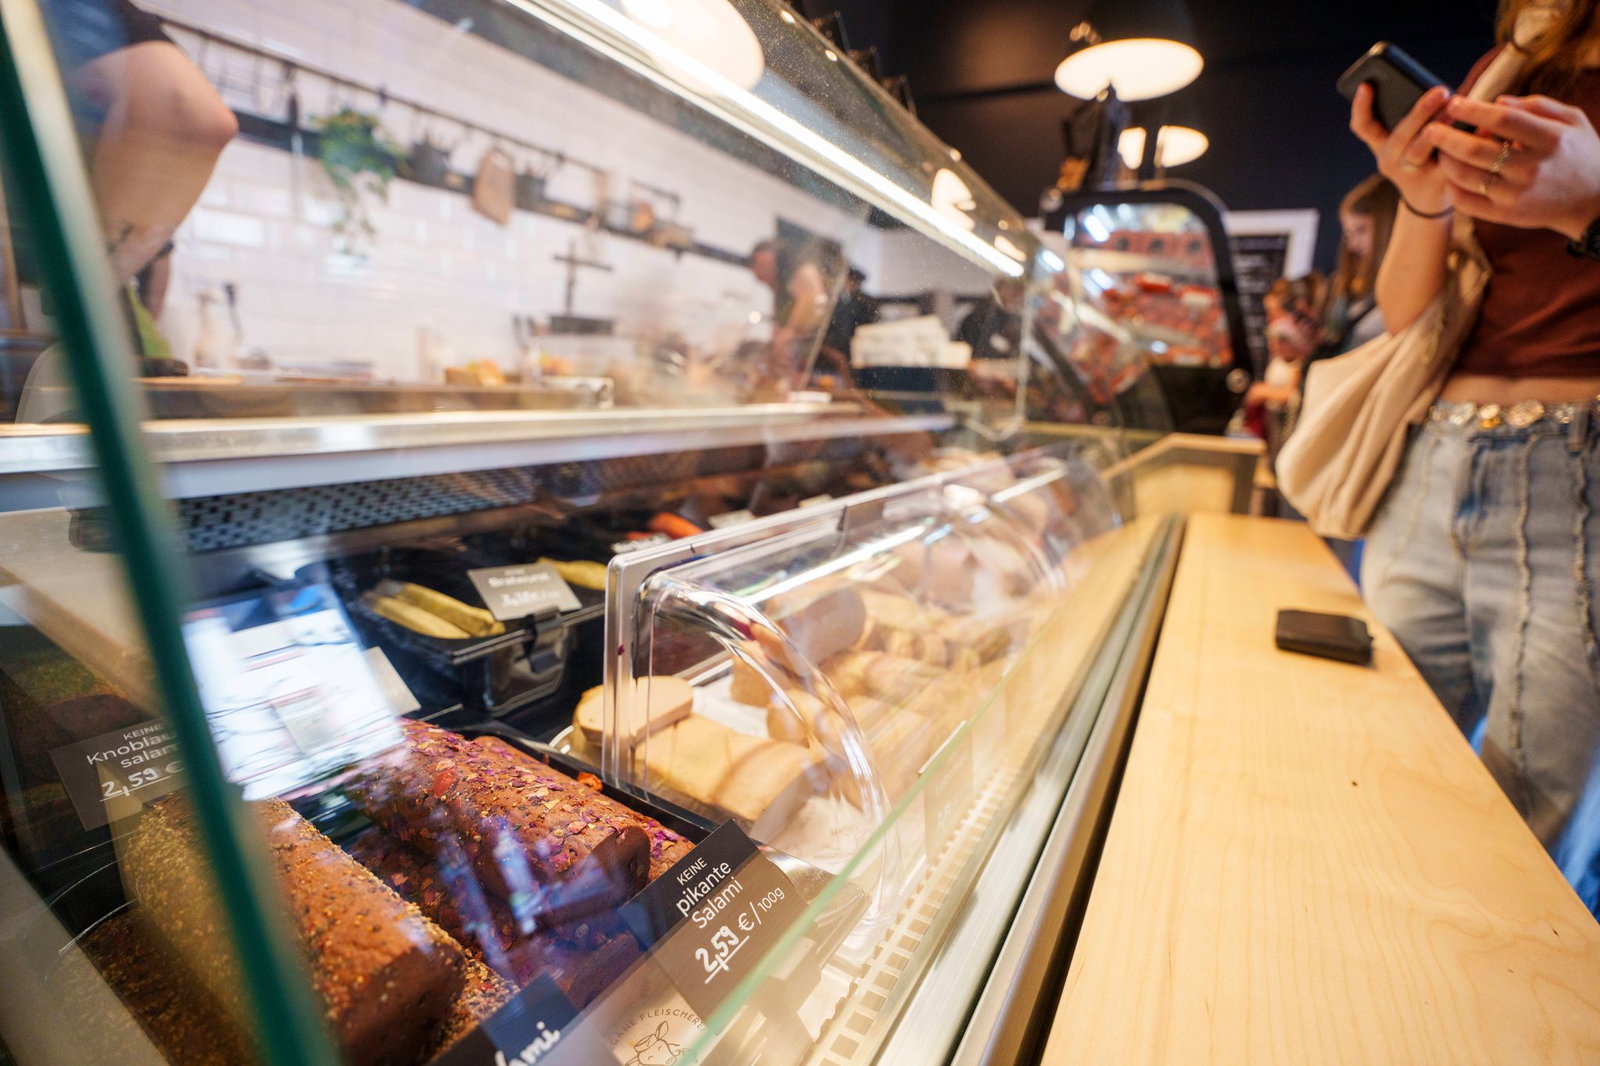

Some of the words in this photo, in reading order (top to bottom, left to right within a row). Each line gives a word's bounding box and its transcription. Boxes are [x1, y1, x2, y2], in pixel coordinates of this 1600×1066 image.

[86, 731, 179, 765] Knoblau
[101, 767, 160, 798] 2,59
[675, 861, 732, 918] pikante
[676, 857, 708, 886] KEINE
[691, 876, 744, 929] Salami
[695, 925, 740, 973] 2,59
